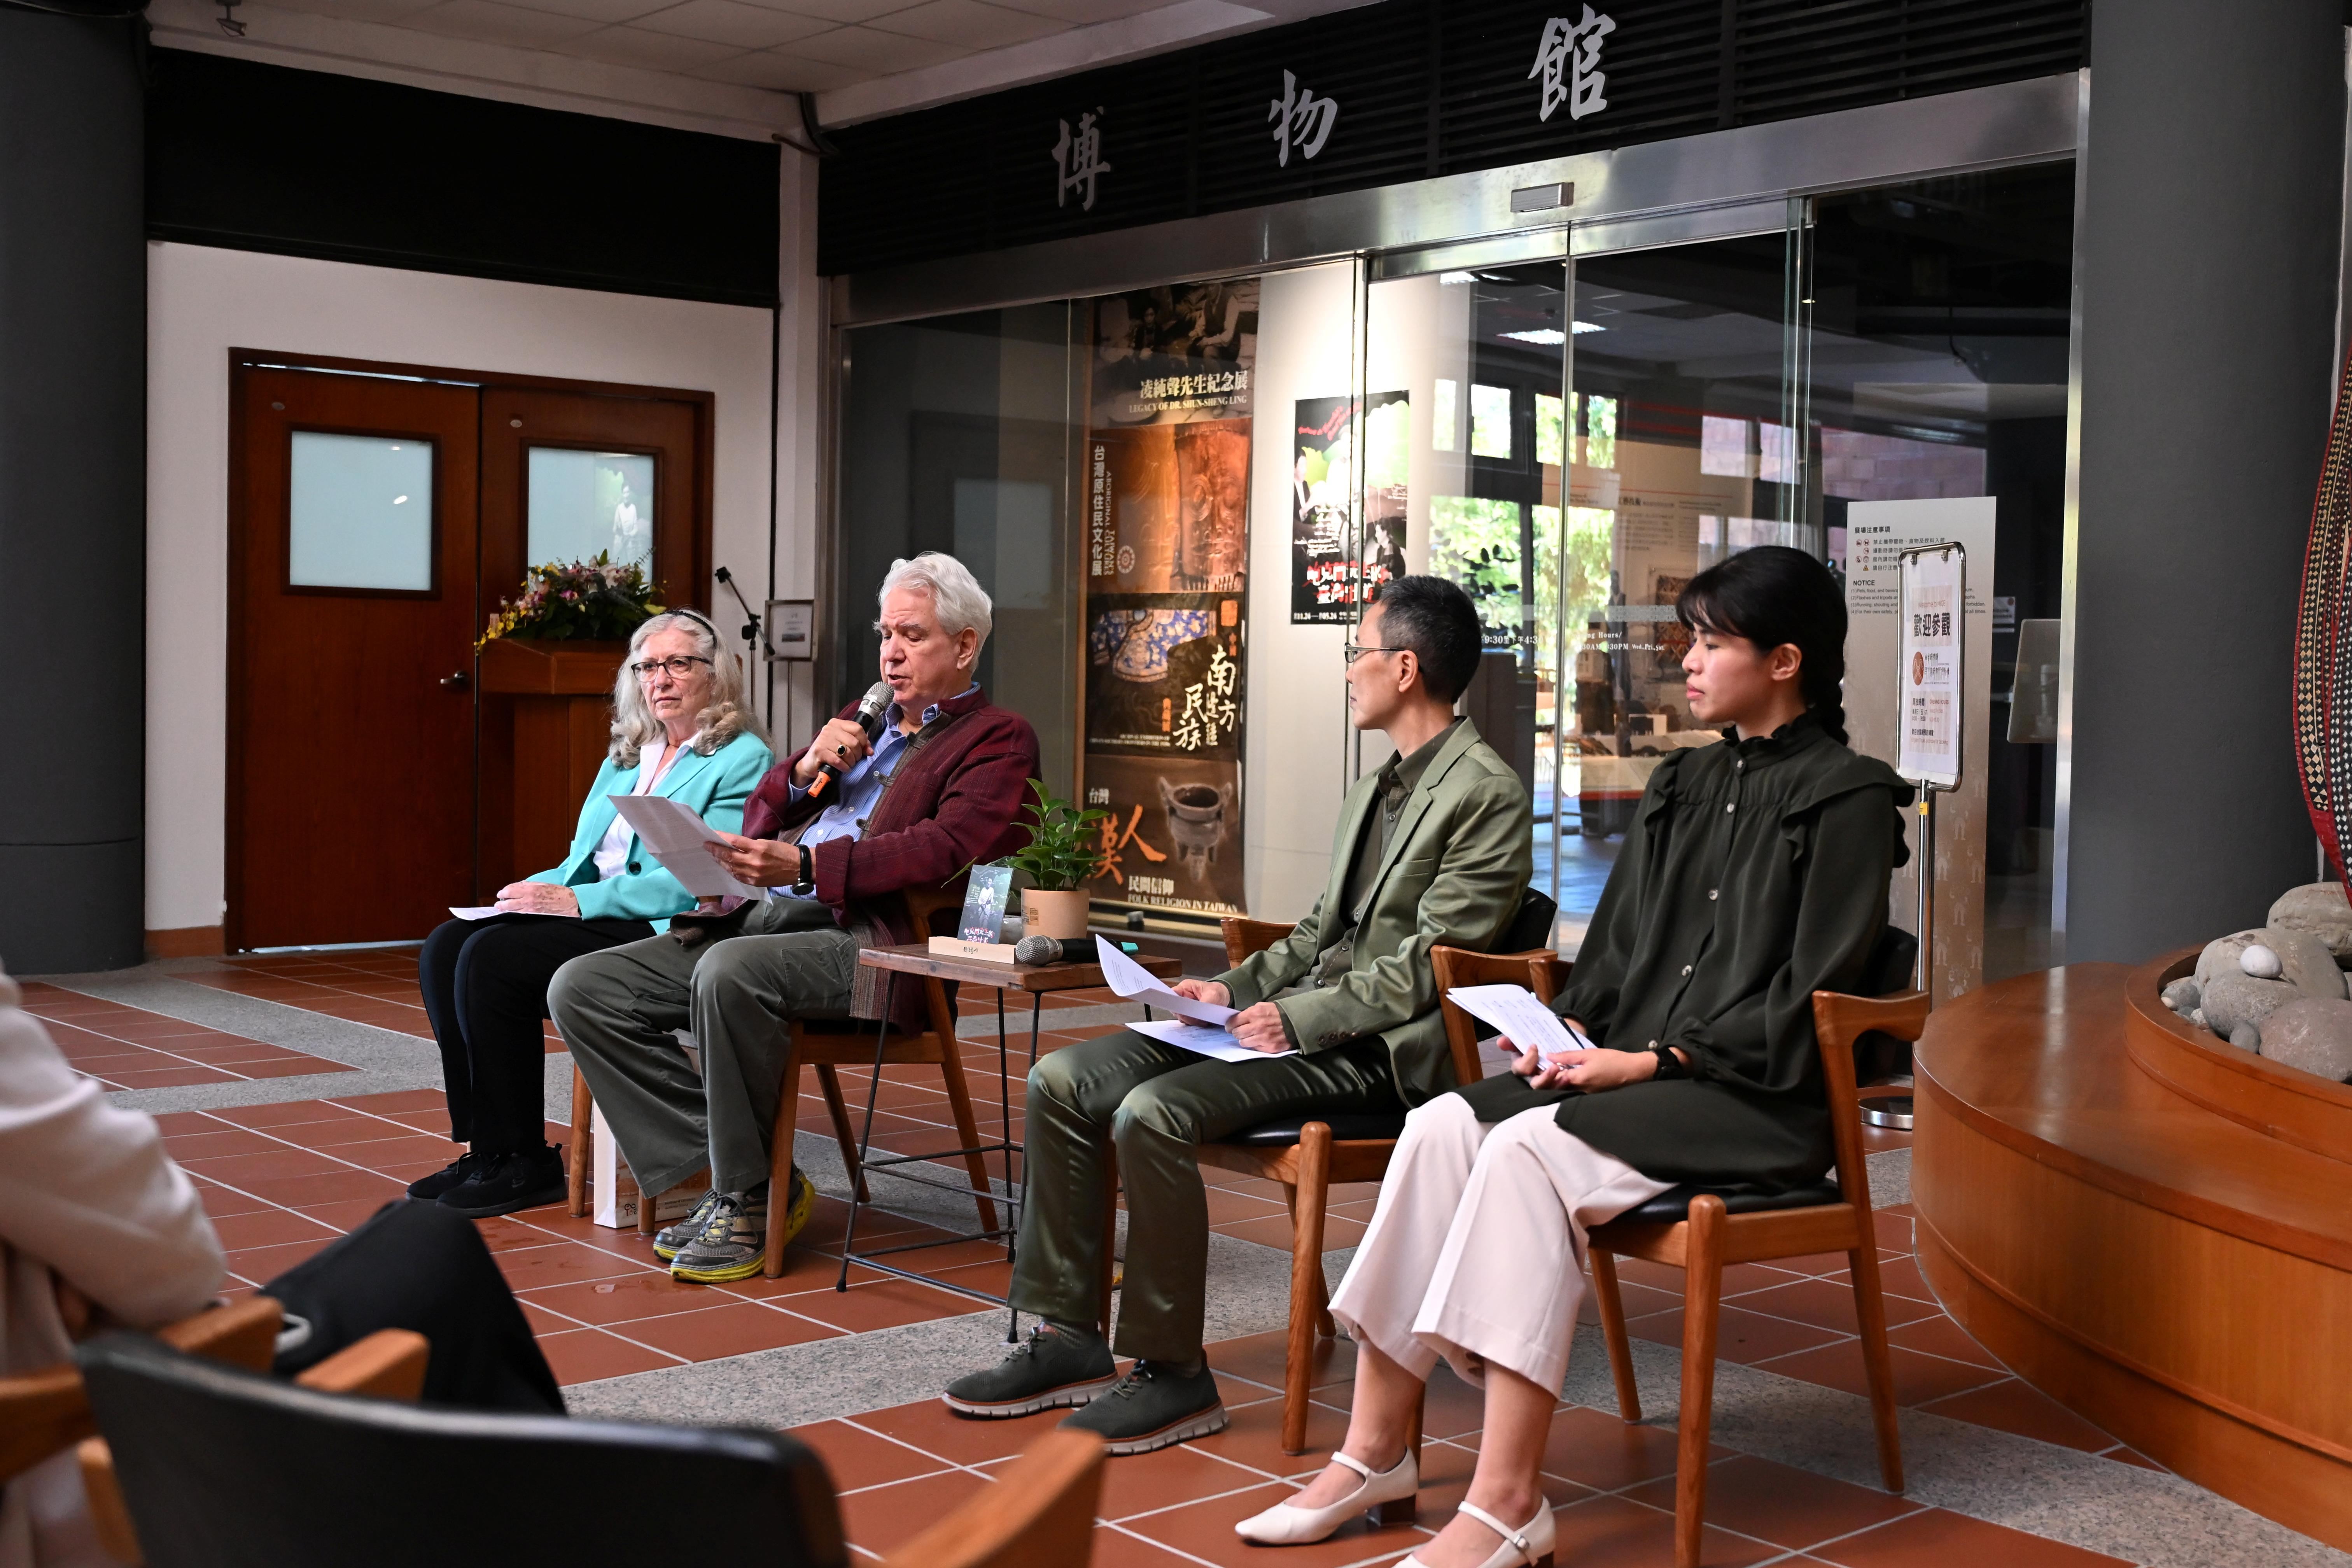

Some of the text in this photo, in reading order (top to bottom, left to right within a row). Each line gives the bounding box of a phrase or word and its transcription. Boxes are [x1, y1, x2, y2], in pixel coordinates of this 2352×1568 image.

[1140, 370, 1248, 399] 凌純聲先生紀念展
[1129, 404, 1158, 413] LEGACY
[1158, 402, 1168, 411] OF
[1183, 397, 1228, 408] SHUN-SHENG
[1229, 395, 1247, 404] LING
[1091, 445, 1105, 576] 台灣原住民文化展
[1914, 612, 1950, 637] 歡迎參觀
[1207, 644, 1236, 732] 南方
[1172, 682, 1208, 751] 民族
[1089, 787, 1110, 805] 台灣
[1128, 875, 1174, 896] 民間信仰
[1128, 894, 1238, 913] FOLK RELIGION IN TAIWAN
